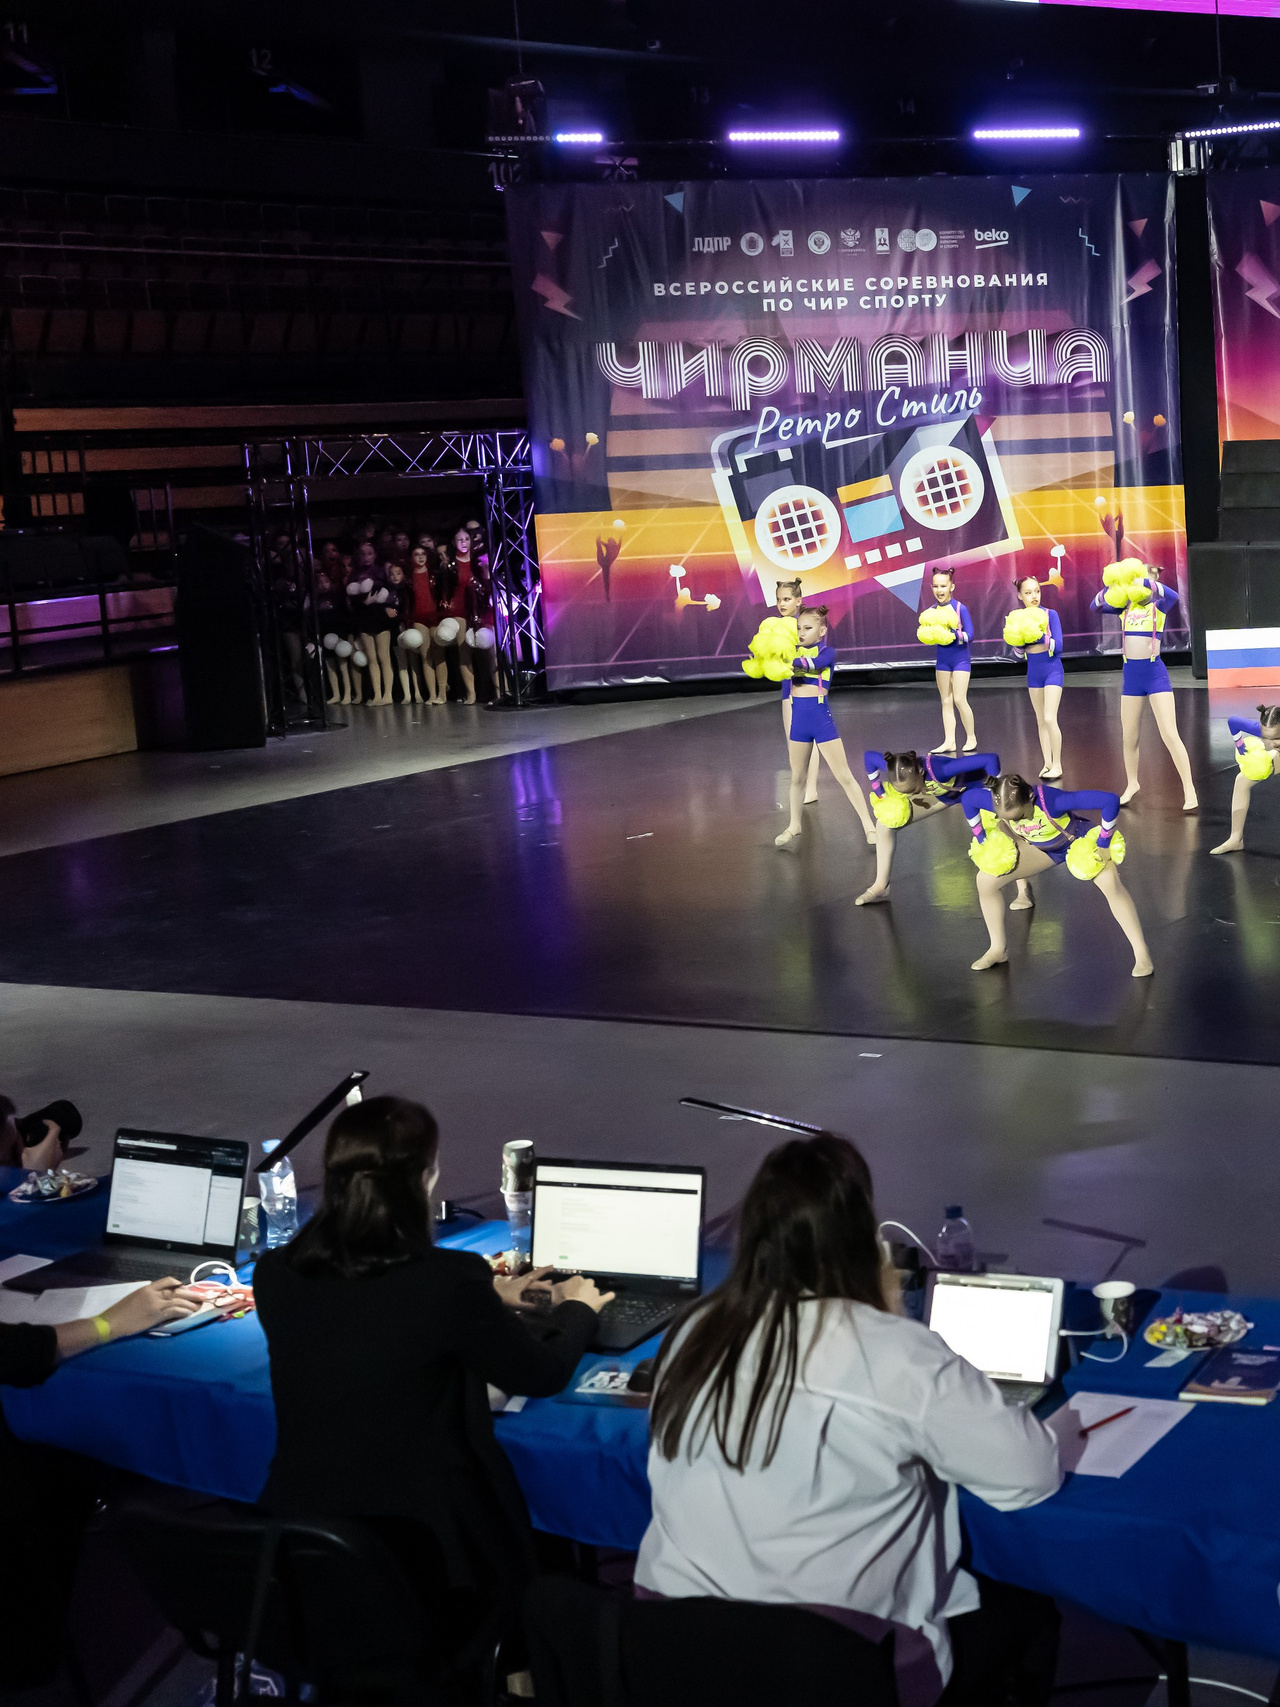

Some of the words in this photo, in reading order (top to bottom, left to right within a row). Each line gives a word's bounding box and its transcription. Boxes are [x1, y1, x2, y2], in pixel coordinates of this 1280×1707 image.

[974, 228, 1009, 241] beko
[692, 237, 731, 254] ЛДПР
[653, 276, 855, 296] ВСЕРОССИЙСКИЕ
[865, 273, 1048, 291] СОРЕВНОВАНИЯ
[763, 299, 793, 312] ПО
[803, 297, 849, 310] ЧИР
[859, 294, 947, 309] СПОРТУ
[754, 406, 862, 448] Ретро
[876, 386, 983, 426] Стиль
